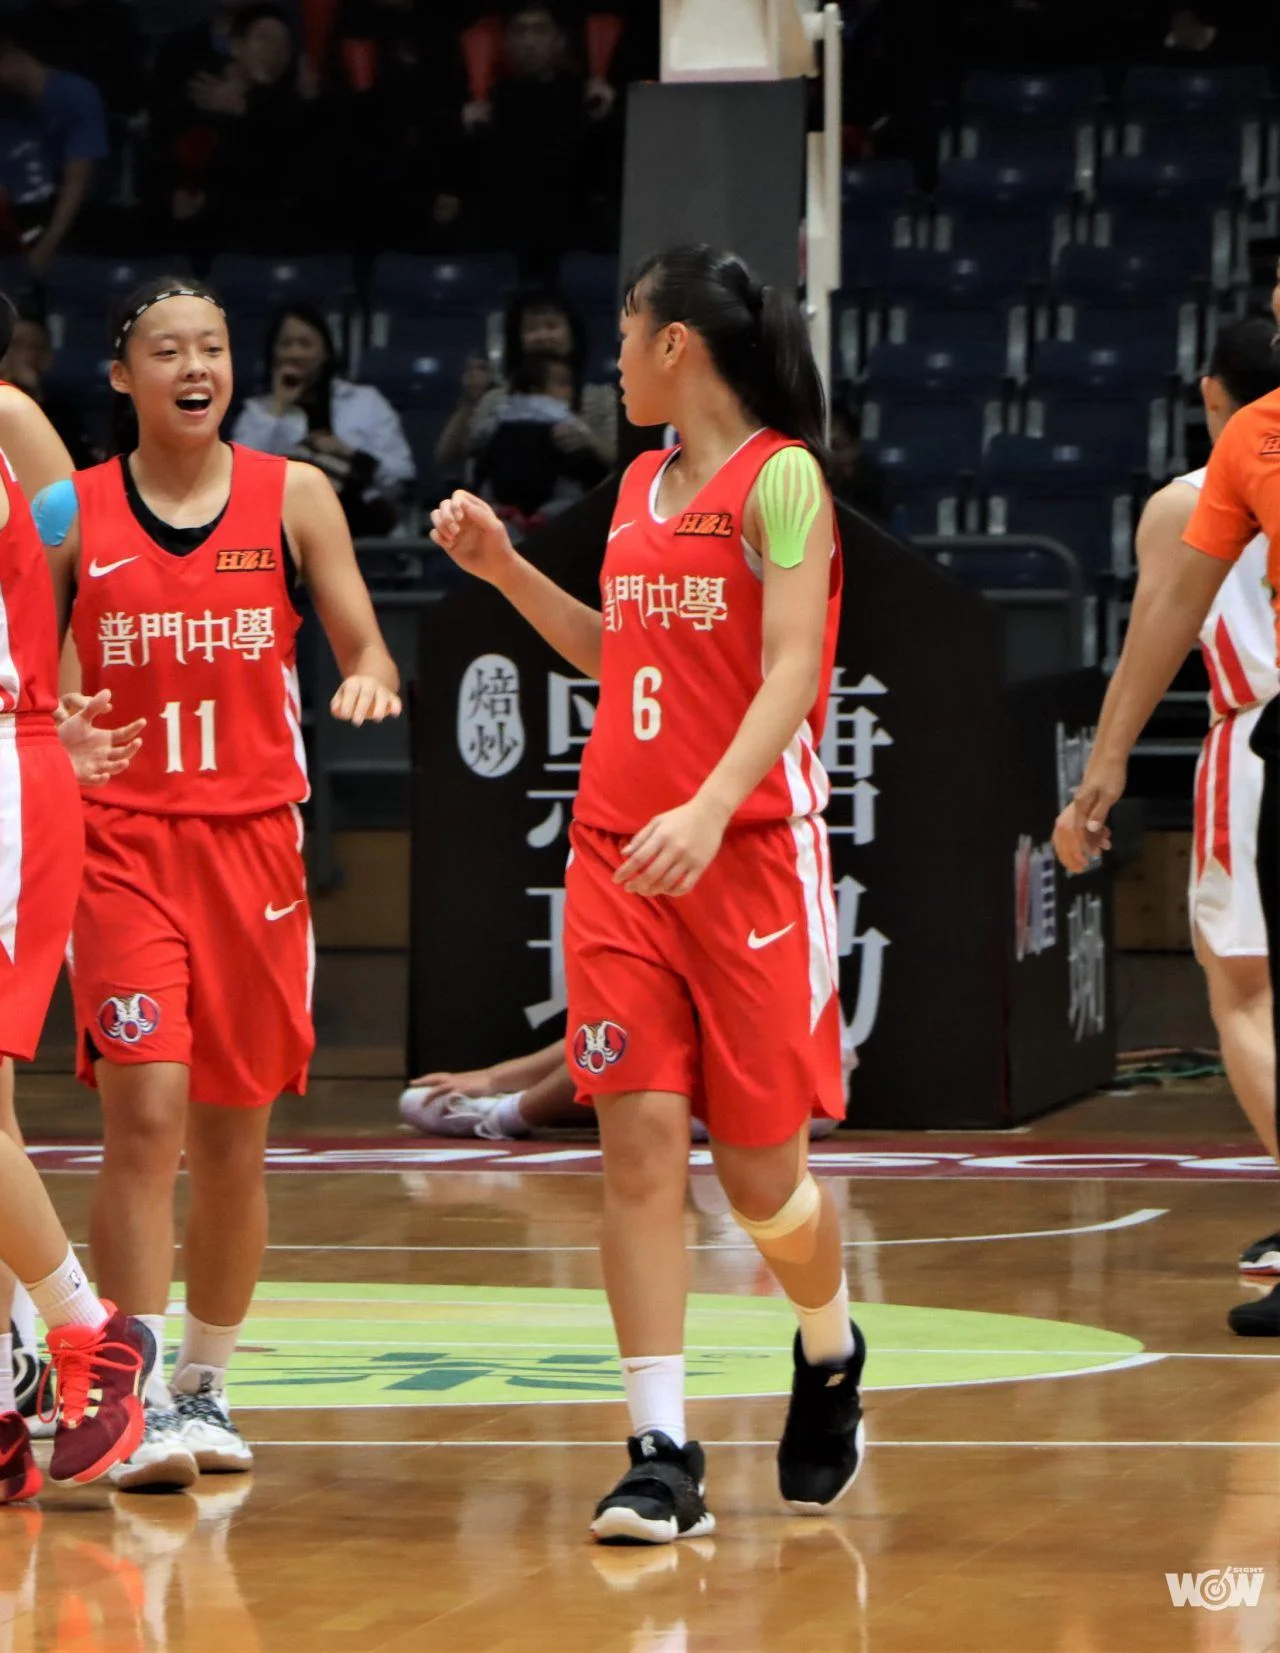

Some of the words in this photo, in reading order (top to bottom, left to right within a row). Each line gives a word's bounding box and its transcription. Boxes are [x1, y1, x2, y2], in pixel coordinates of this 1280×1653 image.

[97, 606, 276, 668] 普門中學
[159, 699, 219, 774] 11
[467, 665, 520, 774] 焙炒
[632, 665, 663, 742] 6
